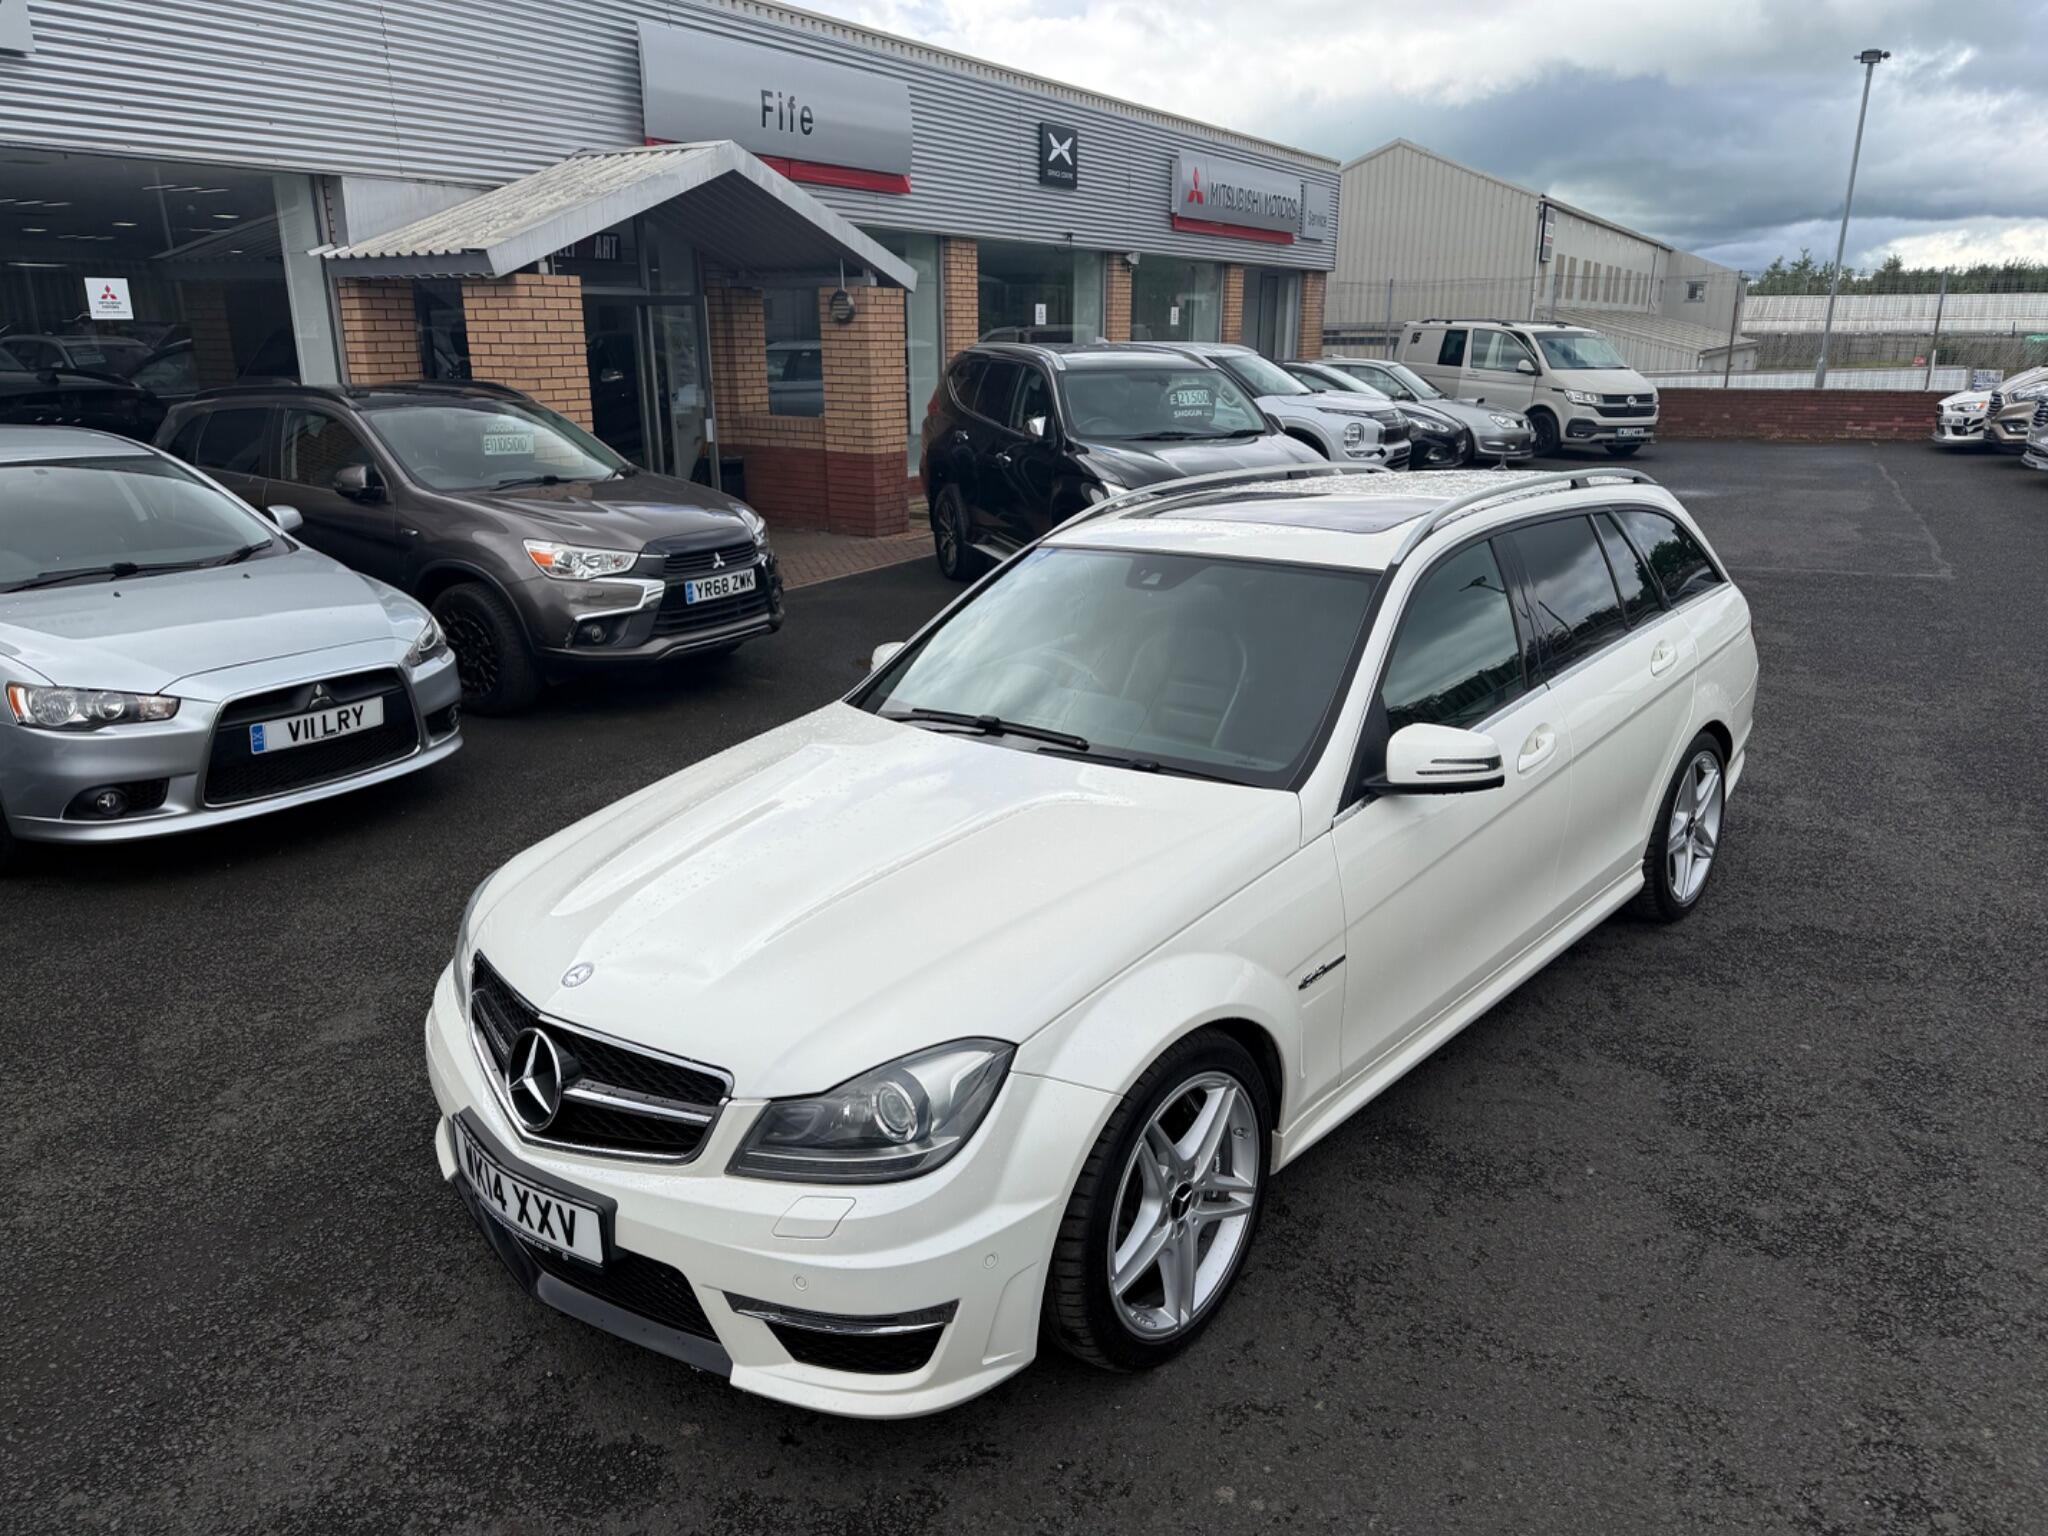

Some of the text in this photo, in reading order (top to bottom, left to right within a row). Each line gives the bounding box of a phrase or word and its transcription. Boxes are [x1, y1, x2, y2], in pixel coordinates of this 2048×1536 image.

[760, 89, 814, 136] Fife
[1210, 182, 1298, 220] MITSUBISHI MOTORS
[695, 571, 755, 600] YR68 ZWK
[511, 1182, 576, 1248] XXV
